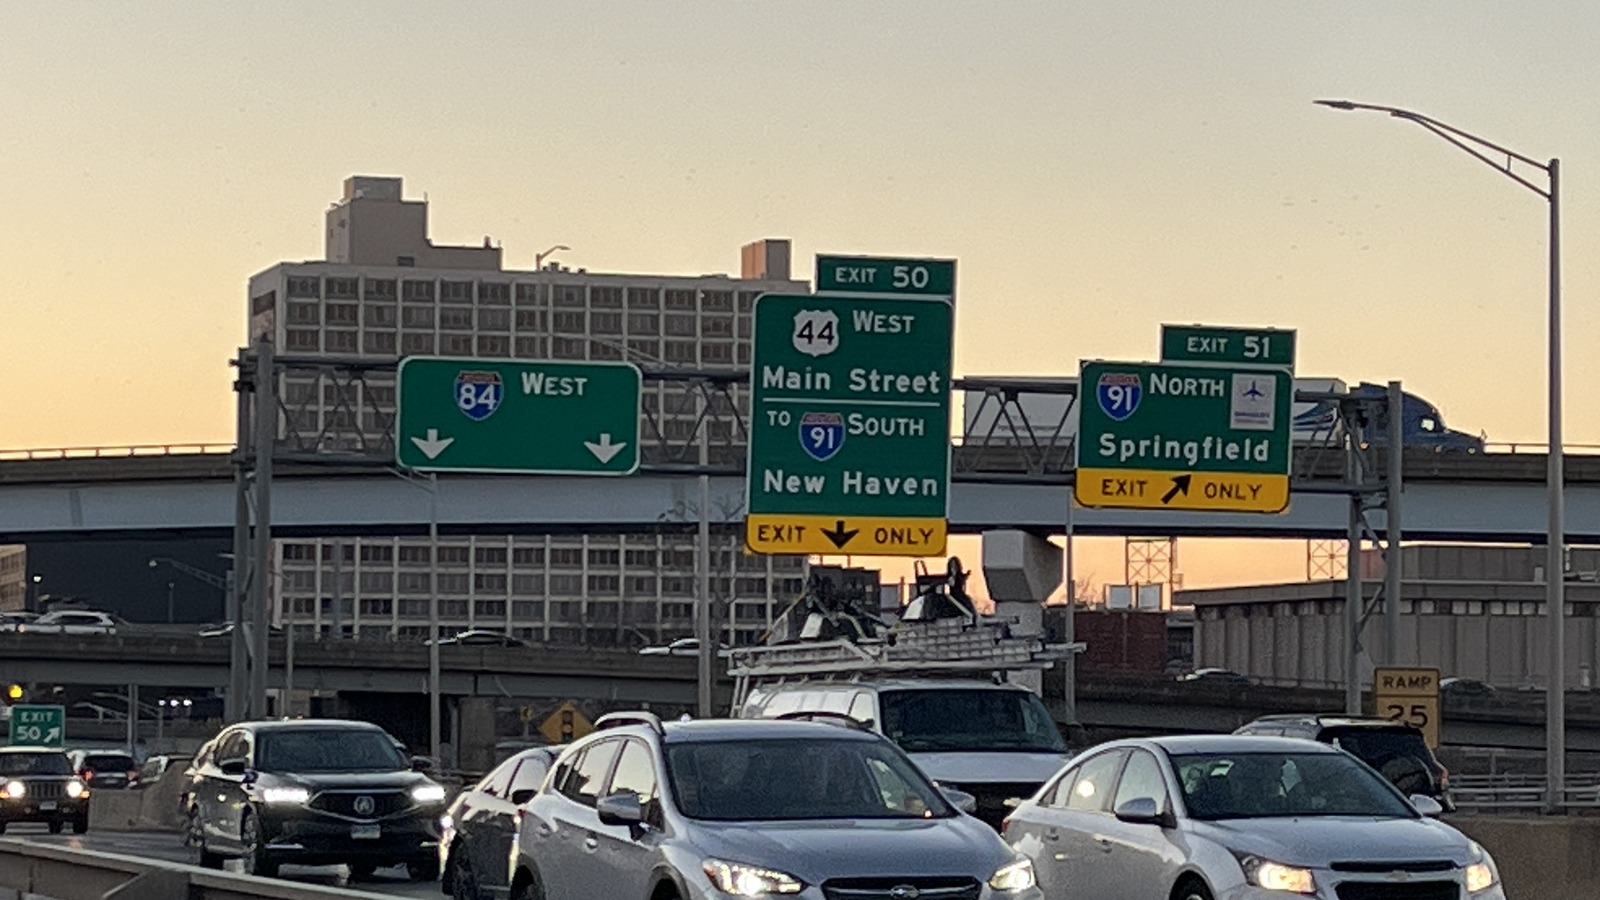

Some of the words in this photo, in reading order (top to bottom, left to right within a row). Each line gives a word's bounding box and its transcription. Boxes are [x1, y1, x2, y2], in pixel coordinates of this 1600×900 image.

[835, 267, 877, 283] EXIT
[892, 266, 929, 288] 50
[796, 319, 835, 345] 44
[852, 310, 914, 334] WEST
[1187, 337, 1229, 353] EXIT
[1243, 336, 1270, 358] 51
[459, 383, 497, 410] 84
[521, 372, 588, 396] WEST
[762, 365, 831, 390] Main
[849, 368, 940, 394] Street
[1107, 386, 1132, 412] 91
[1149, 372, 1224, 397] NORTH
[767, 411, 791, 426] TO
[810, 426, 835, 449] 91
[848, 413, 924, 436] SOUTH
[1099, 433, 1269, 466] Springfield
[764, 470, 825, 494] New
[843, 471, 938, 496] Haven
[1102, 479, 1148, 496] EXIT
[1204, 482, 1263, 500] ONLY
[757, 525, 806, 542] EXIT
[874, 527, 934, 545] ONLY
[1382, 675, 1432, 689] RAMP
[20, 711, 54, 723] EXIT
[1387, 704, 1428, 728] 25
[17, 725, 41, 741] 50
